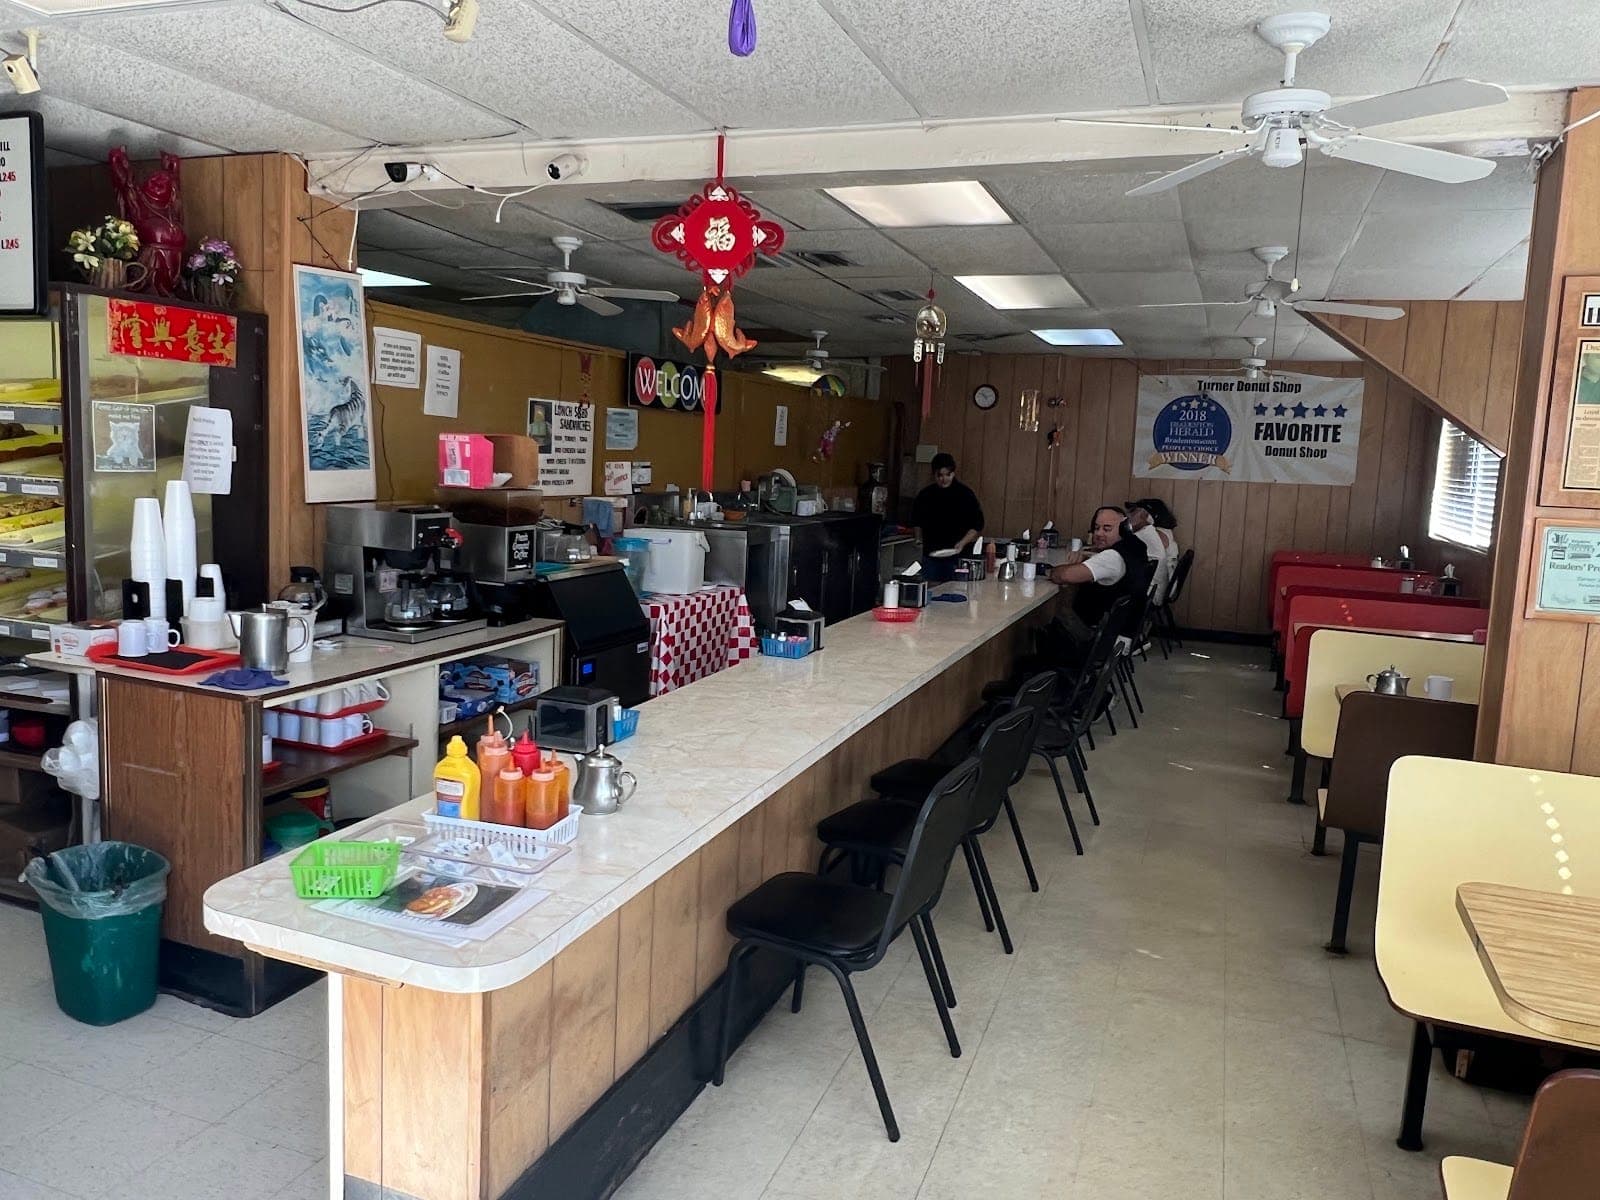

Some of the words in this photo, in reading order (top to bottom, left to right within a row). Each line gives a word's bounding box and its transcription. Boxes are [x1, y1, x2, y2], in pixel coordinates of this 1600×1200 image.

[704, 216, 736, 252] 福
[638, 367, 709, 402] WELCOM
[1197, 380, 1234, 392] Turner
[1237, 380, 1270, 392] Donut
[1272, 381, 1302, 394] Shop
[1179, 410, 1207, 421] 2018
[1169, 427, 1214, 437] HERALD
[1254, 423, 1342, 443] FAVORITE
[1160, 452, 1217, 465] WINNER
[1265, 446, 1297, 458] Donut
[1299, 446, 1328, 459] Shop
[1549, 561, 1587, 571] Readers'
